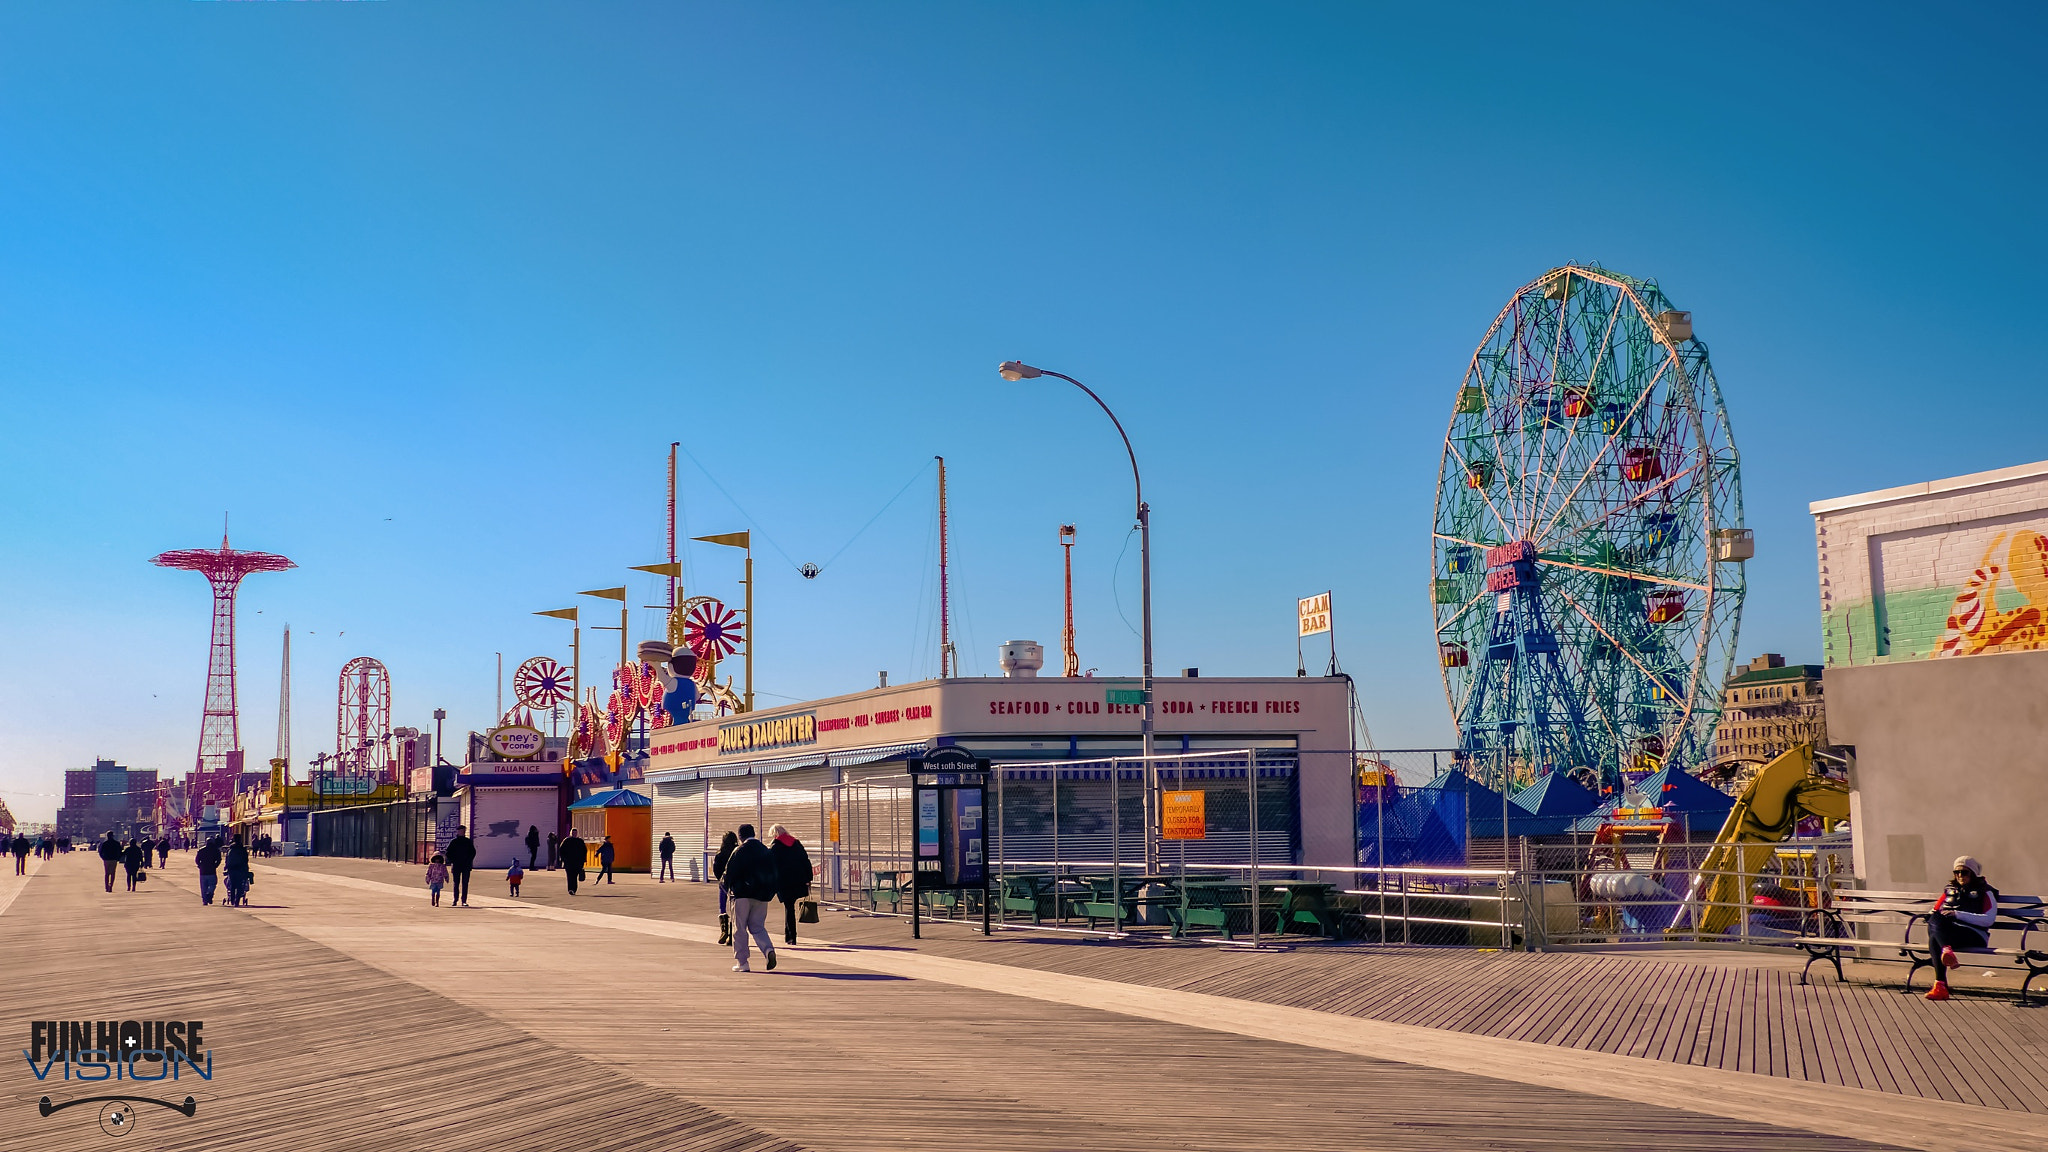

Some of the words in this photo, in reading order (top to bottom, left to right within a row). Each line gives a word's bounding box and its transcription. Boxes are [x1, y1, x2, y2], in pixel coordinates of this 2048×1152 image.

[1300, 595, 1329, 617] CLAM
[1302, 614, 1327, 633] BAR
[990, 701, 1049, 714] SEAFOOD
[1068, 701, 1100, 714] COLD
[1107, 703, 1140, 714] BEER
[1162, 701, 1194, 714] SODA
[1212, 701, 1258, 714] FRENCH
[1266, 701, 1300, 714] FRIES
[494, 732, 539, 744] coney's
[718, 724, 752, 752] PAUL'S
[753, 714, 815, 748] DAUGHTER
[509, 742, 535, 750] cones
[494, 765, 525, 773] ITALIAN
[526, 765, 540, 773] ICE
[923, 762, 940, 770] West
[941, 761, 956, 770] 10th
[956, 761, 977, 770] Street
[1167, 816, 1188, 824] CLOSED
[1188, 816, 1201, 824] FOR
[1164, 827, 1203, 836] CONSTRUCTION
